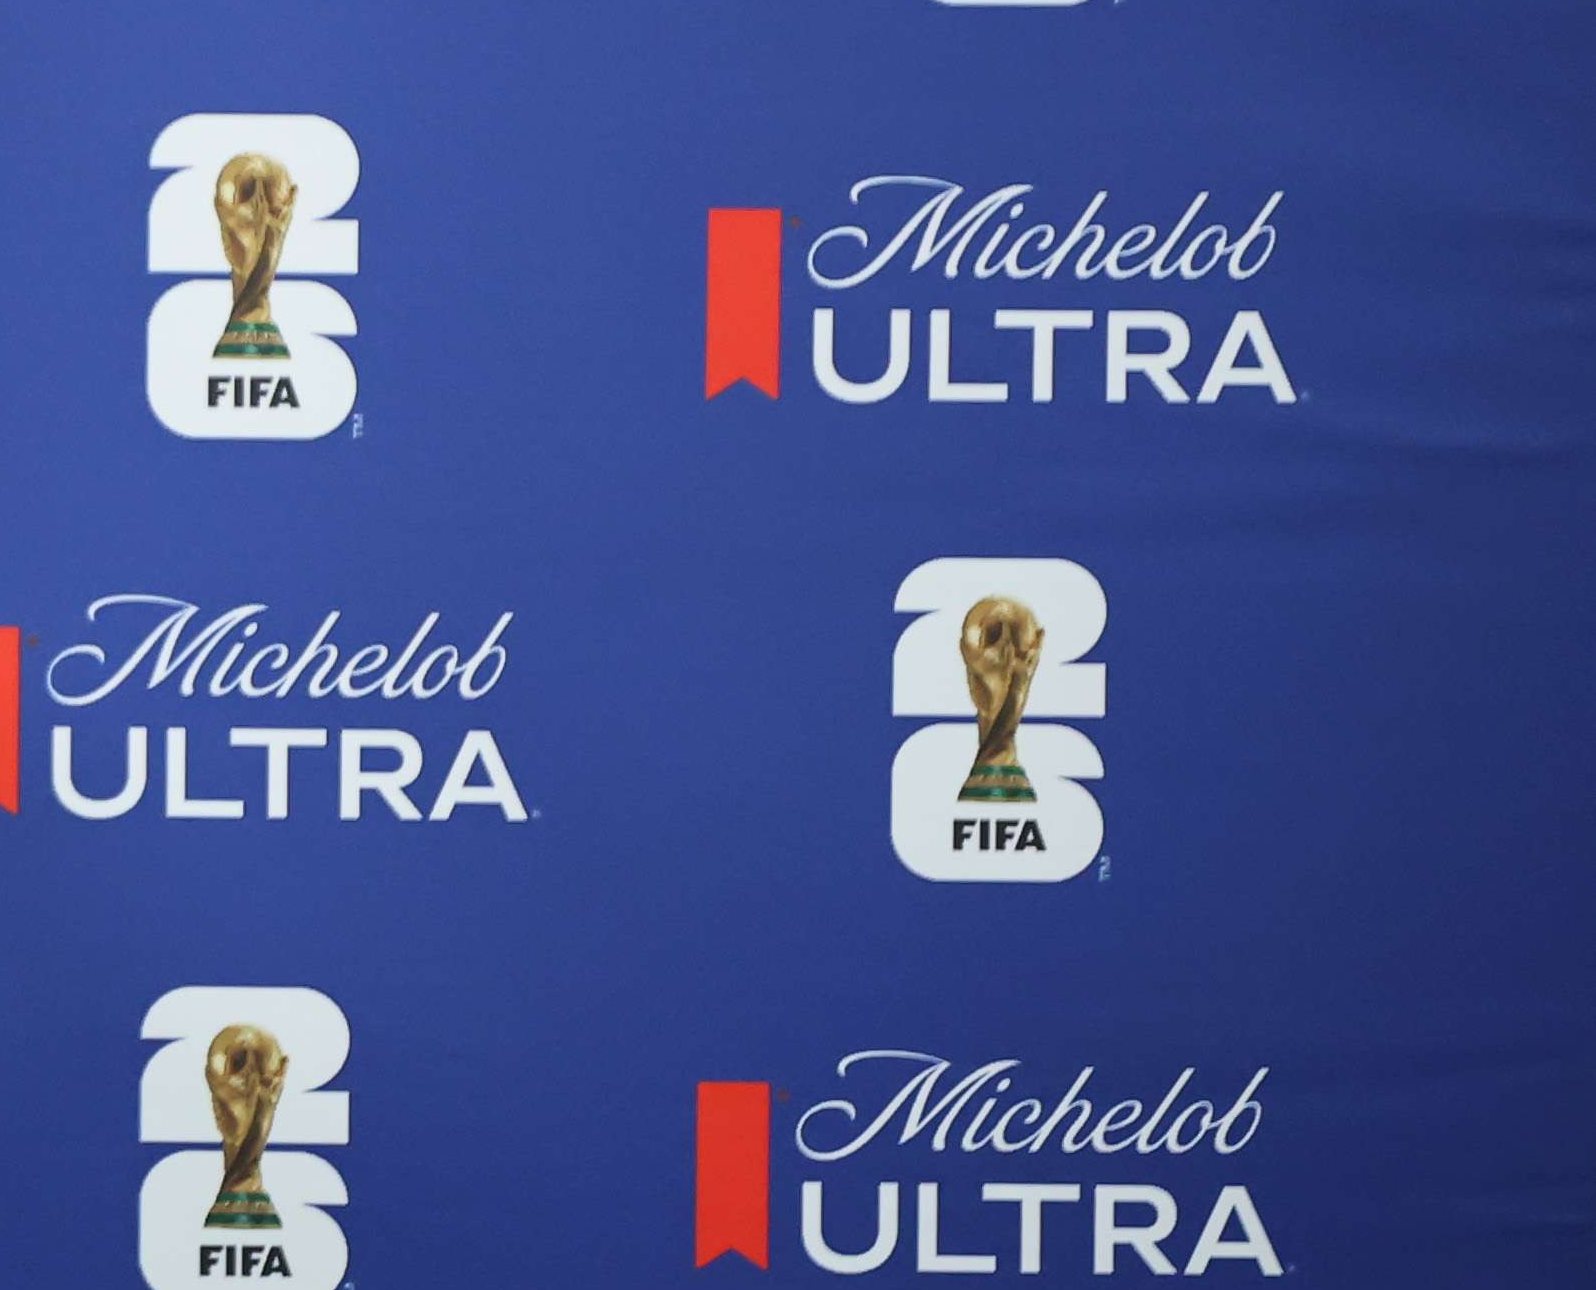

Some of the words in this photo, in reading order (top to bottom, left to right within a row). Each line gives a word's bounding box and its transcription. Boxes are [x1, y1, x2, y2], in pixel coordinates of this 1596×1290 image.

[807, 176, 1283, 289] Michelob
[207, 376, 299, 408] FIFA
[813, 308, 1296, 403] ULTRA
[47, 594, 513, 706] Michelob
[51, 725, 527, 821] ULTRA
[952, 819, 1046, 851] FIFA
[796, 1050, 1269, 1161] Michelob
[199, 1245, 291, 1278] FIFA
[802, 1181, 1283, 1276] ULTRA
